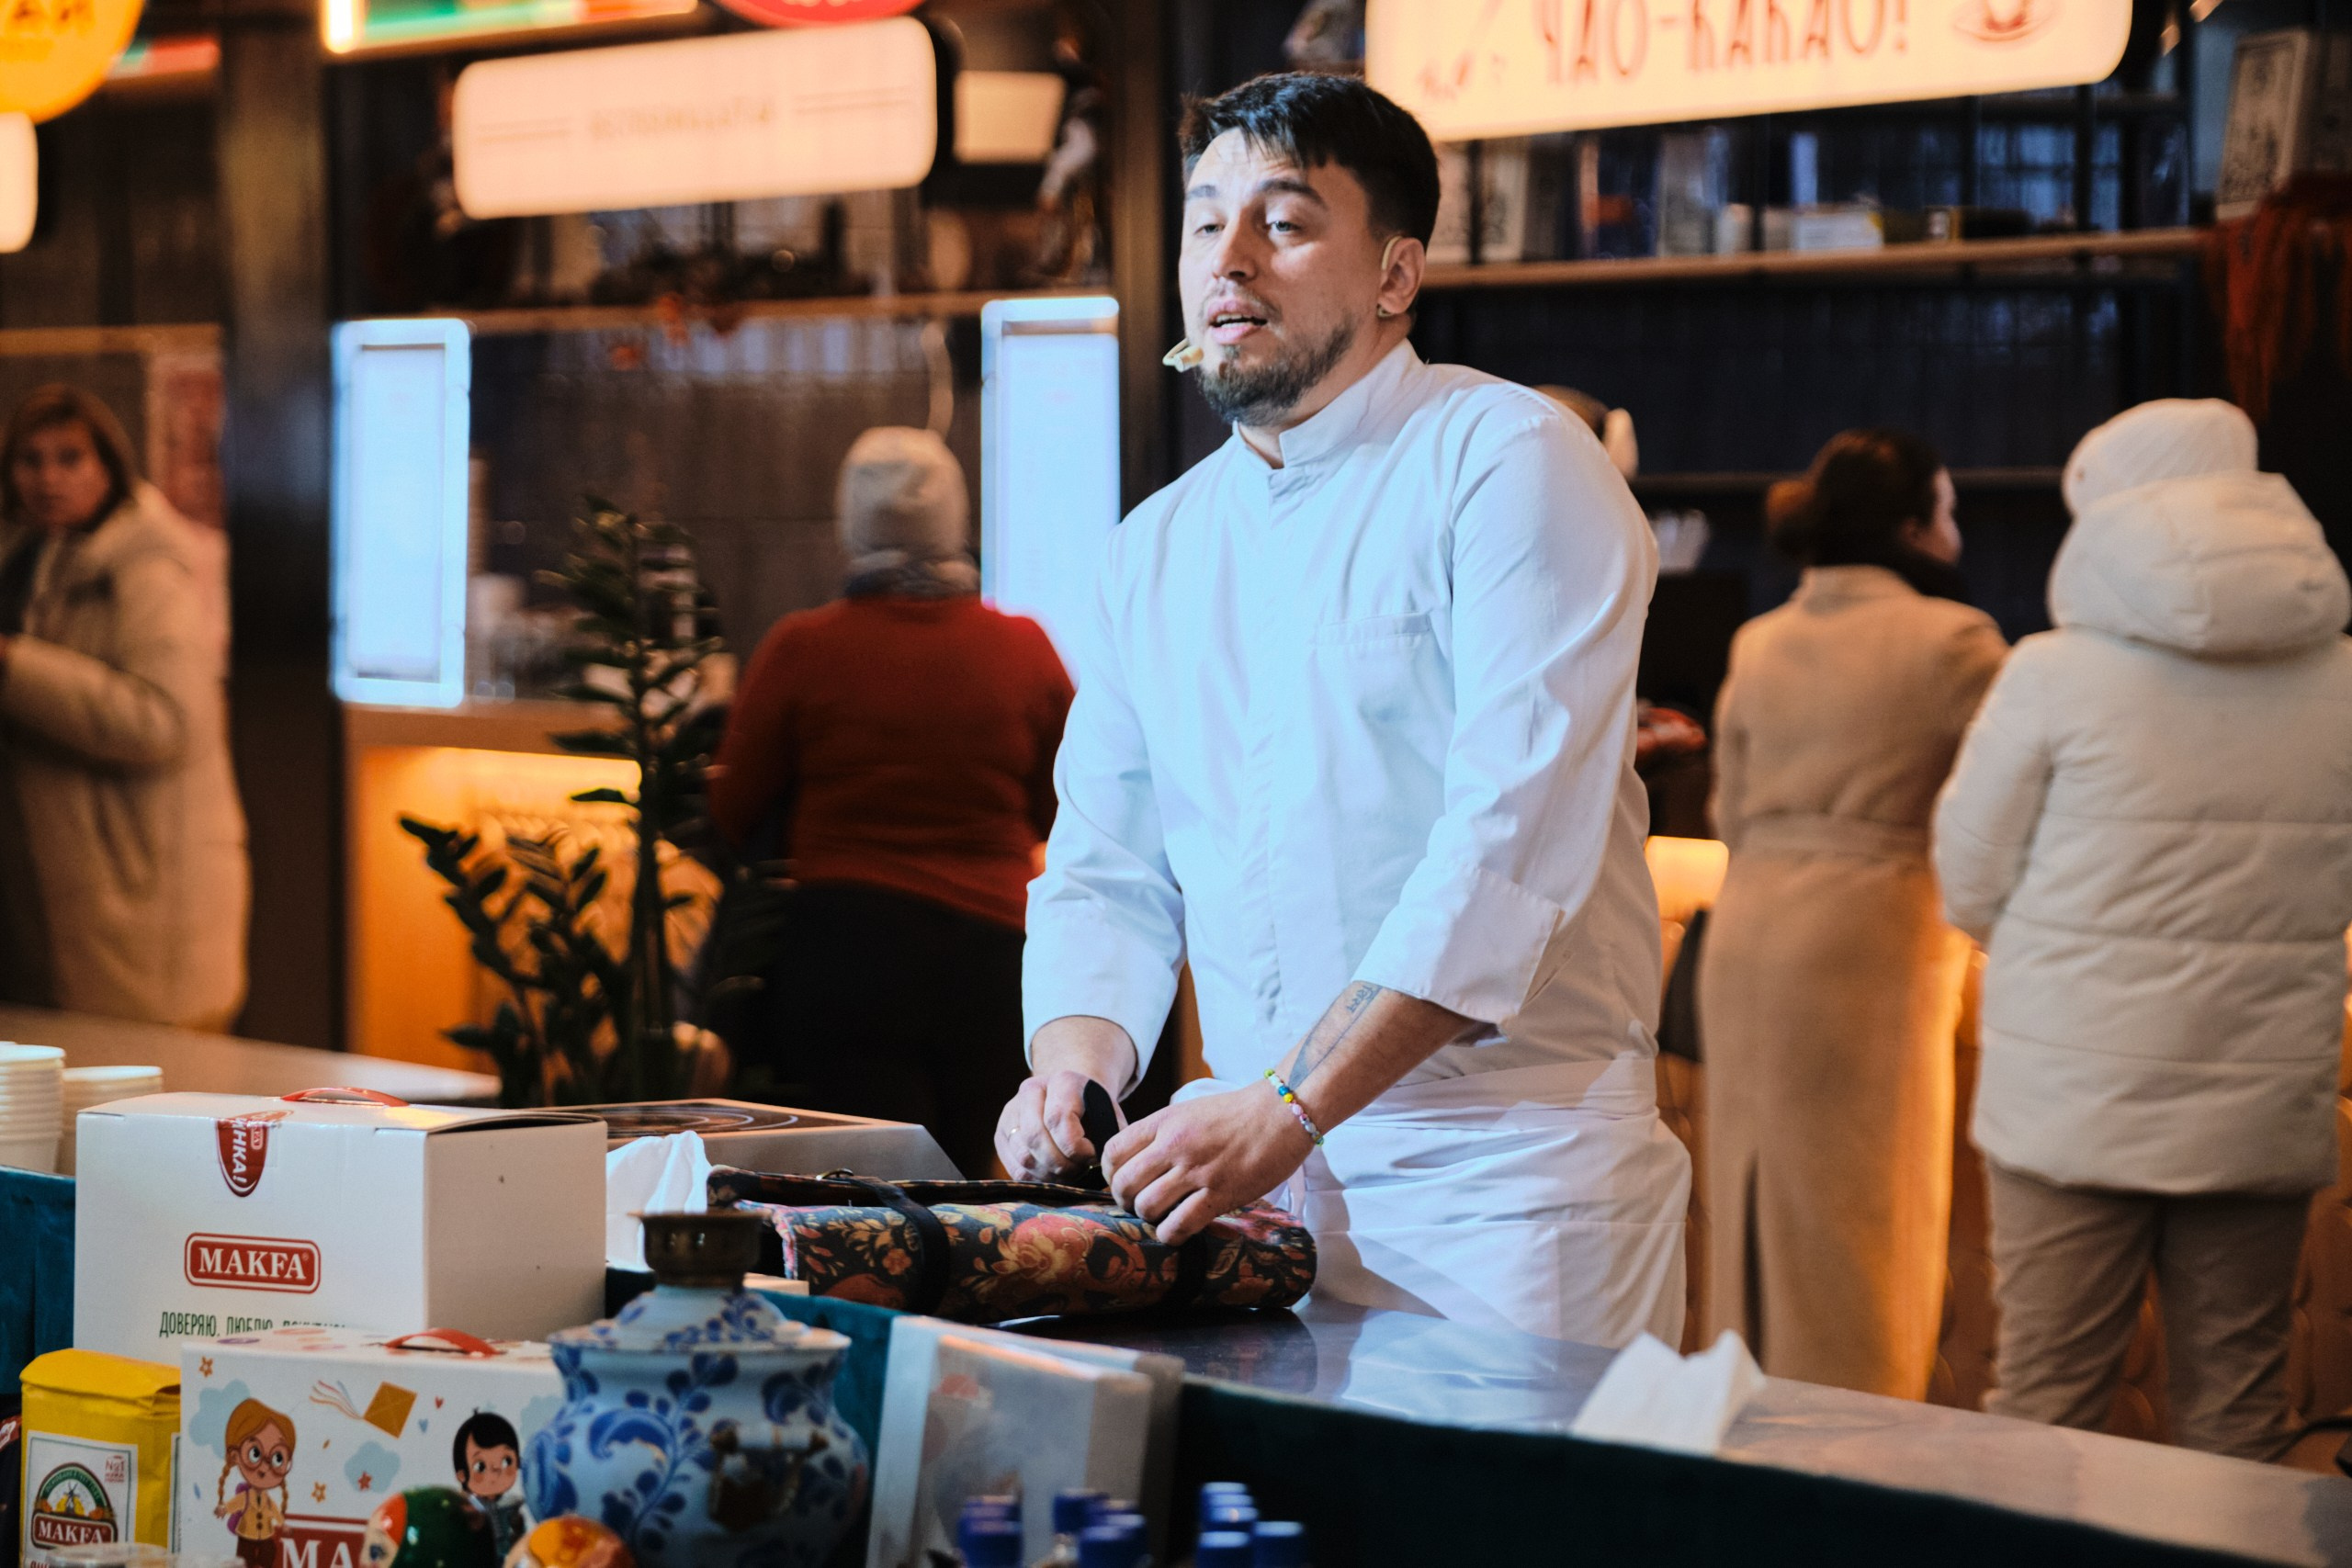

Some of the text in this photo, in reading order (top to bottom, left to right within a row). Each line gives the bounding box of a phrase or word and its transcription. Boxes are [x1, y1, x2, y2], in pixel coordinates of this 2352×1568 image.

[198, 1247, 306, 1279] MAKFA
[38, 1520, 104, 1543] MAKFA
[279, 1538, 354, 1568] MA
